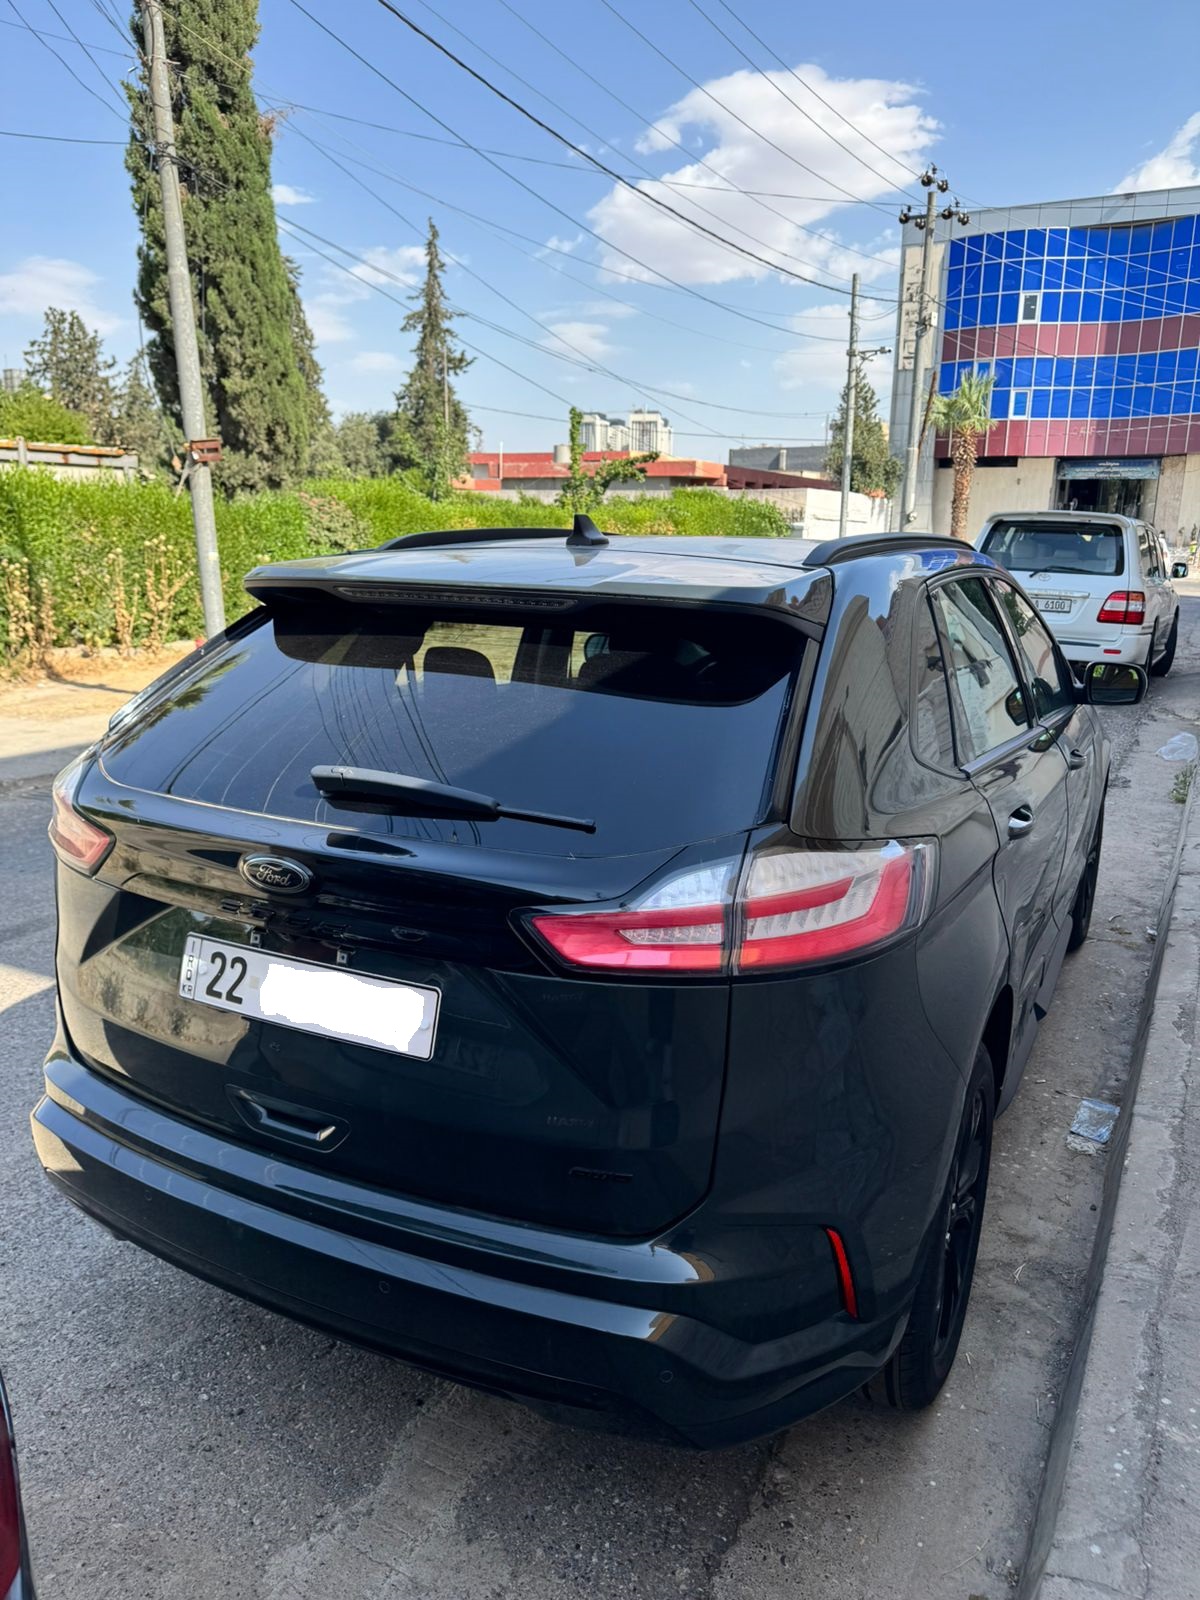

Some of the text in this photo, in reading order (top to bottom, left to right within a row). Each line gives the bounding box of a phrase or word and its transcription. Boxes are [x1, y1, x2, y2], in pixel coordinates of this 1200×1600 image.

[1044, 600, 1066, 610] 6100
[256, 863, 292, 886] Ford
[205, 951, 248, 1005] 22
